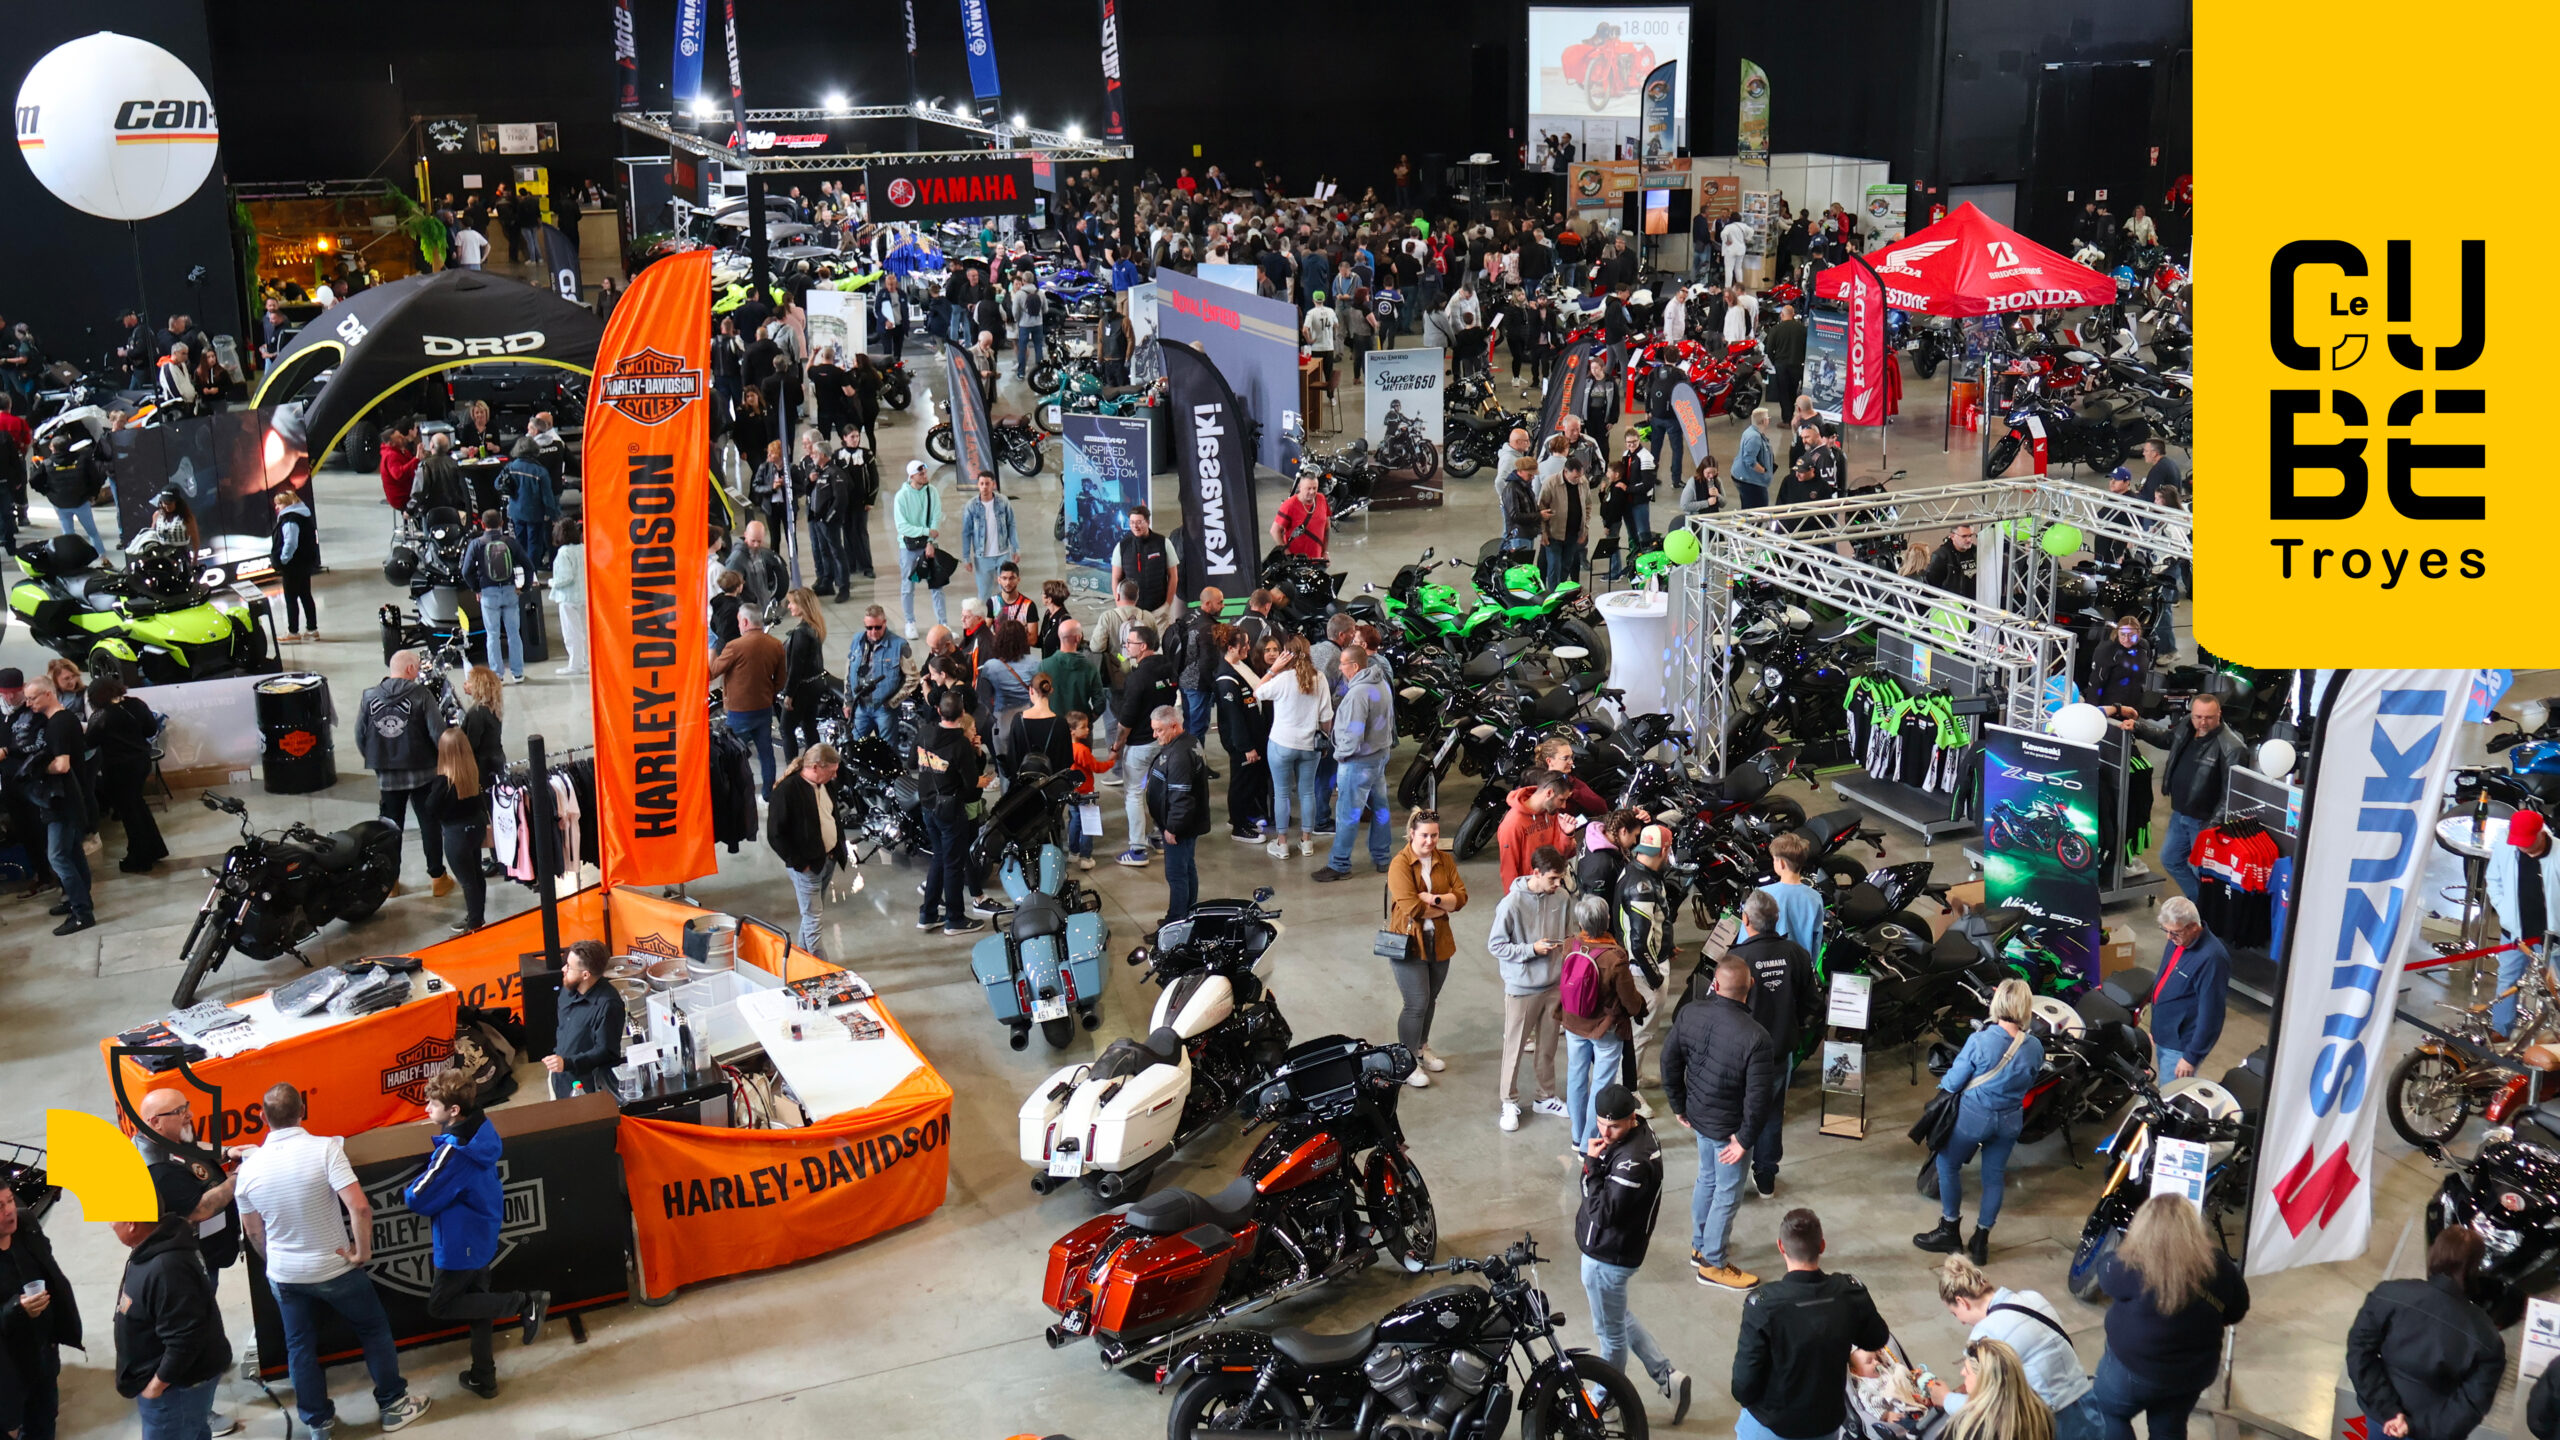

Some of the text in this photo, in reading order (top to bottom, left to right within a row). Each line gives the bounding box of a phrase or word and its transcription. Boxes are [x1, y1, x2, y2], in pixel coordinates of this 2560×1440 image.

[1644, 21, 1669, 35] 000
[916, 174, 1018, 204] YAMAHA
[1875, 264, 1922, 279] HONDA
[1987, 267, 2043, 280] BRIDGESTONE
[1986, 289, 2085, 312] HONDA
[1172, 289, 1241, 331] ROYAL ENFIELD
[1320, 318, 1331, 331] 14
[422, 331, 546, 357] DRD
[625, 356, 674, 375] MOTOR
[606, 377, 695, 397] HARLEY-DAVIDSON
[1382, 381, 1414, 392] METEOR
[1415, 374, 1436, 390] 650
[625, 398, 675, 419] CYCLES
[1082, 444, 1126, 456] INSPIRED
[1072, 464, 1092, 474] FOR
[628, 453, 677, 840] HARLEY-DAVIDSON
[2021, 741, 2061, 757] Kawasaki
[2000, 896, 2083, 926] Ninja 500
[2309, 690, 2446, 1119] SUZUKI
[1763, 958, 1787, 968] YAMAHA
